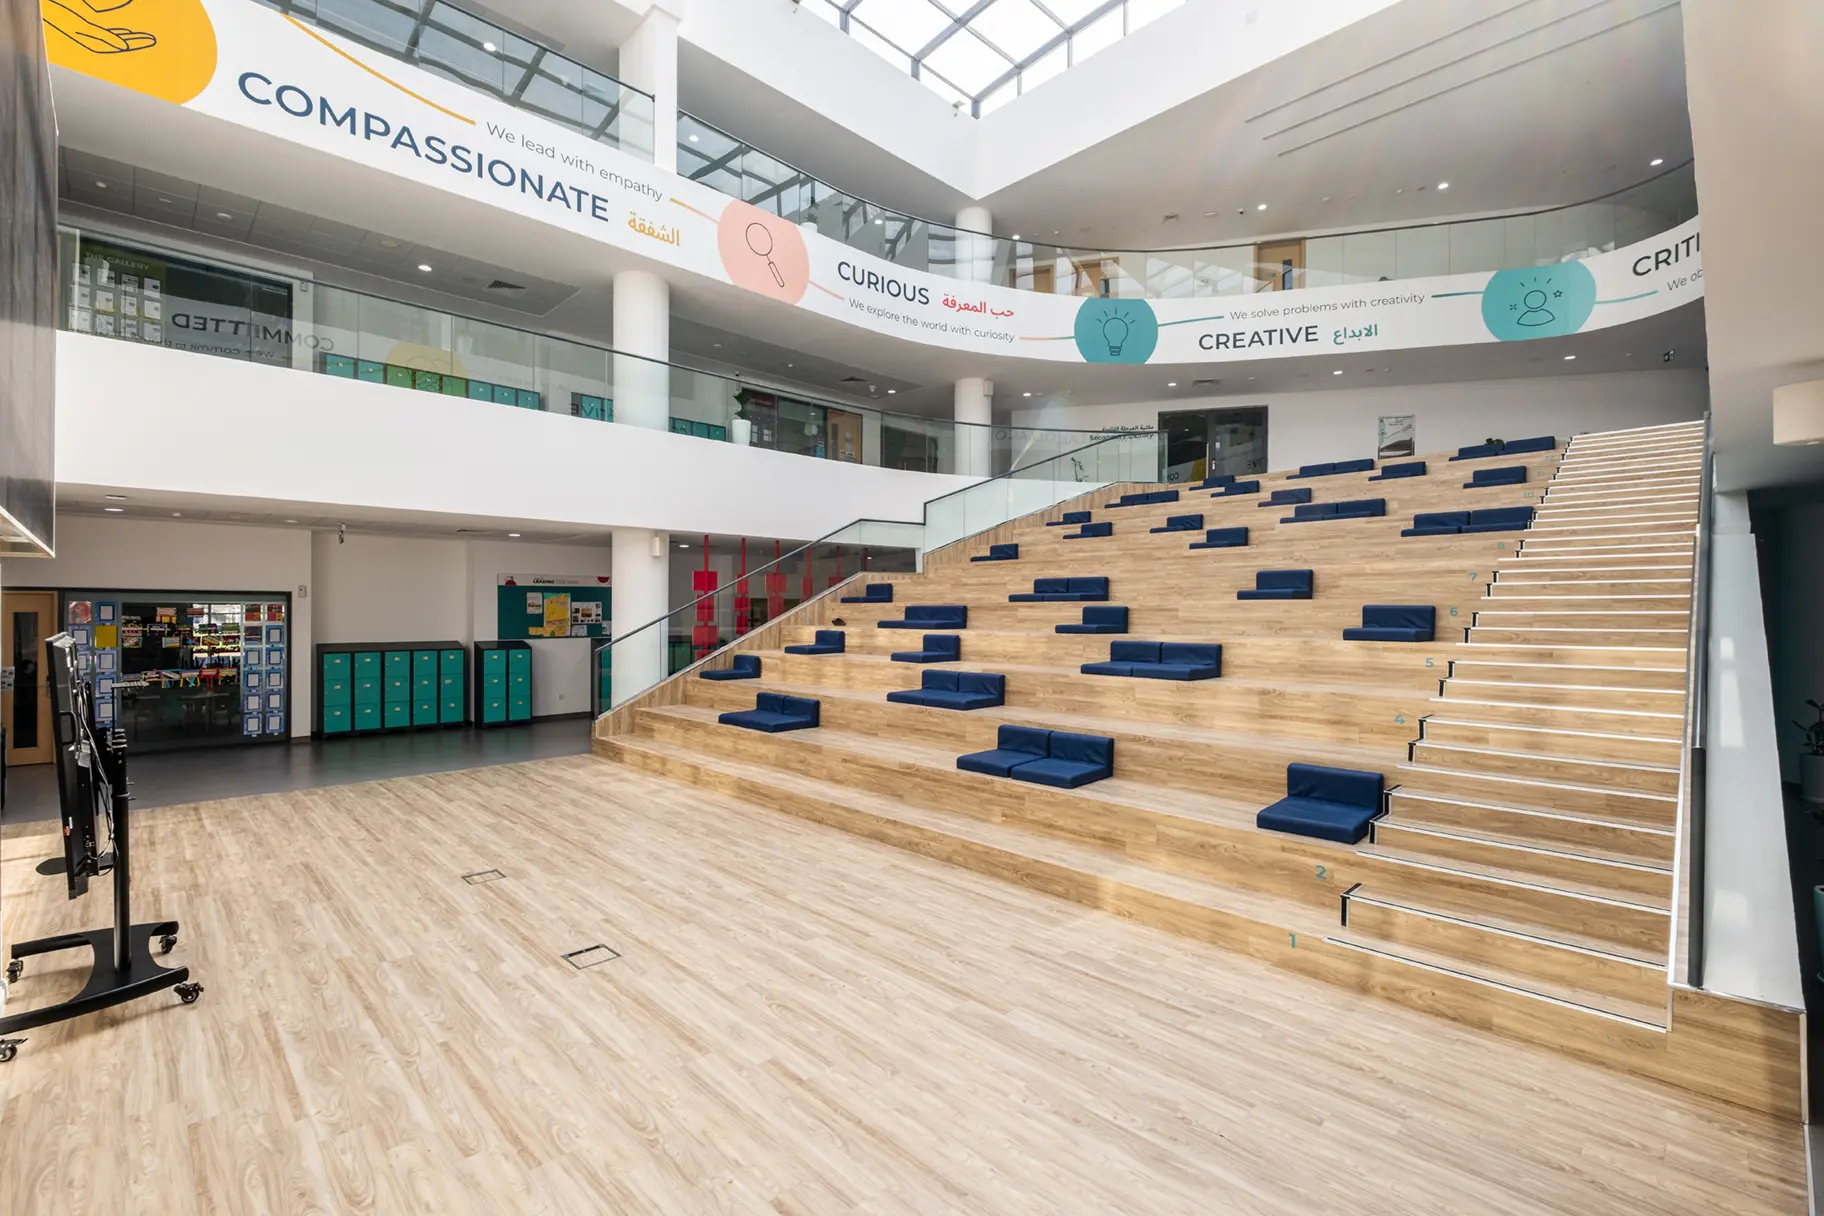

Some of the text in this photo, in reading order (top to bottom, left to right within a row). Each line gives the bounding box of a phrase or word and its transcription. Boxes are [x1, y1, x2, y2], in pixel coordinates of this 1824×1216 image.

[237, 71, 609, 223] COMPASSIONATE
[486, 120, 663, 203] We lead with empathy
[627, 210, 681, 247] الشفقة
[106, 256, 150, 271] GALLERY
[837, 261, 930, 306] CURIOUS
[1667, 277, 1687, 291] We
[941, 293, 1015, 320] حب المعرفة
[1229, 293, 1425, 321] We solve problems with creativity
[849, 297, 1015, 344] We explore the world with curiosity
[1199, 325, 1319, 351] CREATIVE
[1333, 324, 1379, 345] الابداع
[1469, 572, 1477, 580] 7
[1450, 607, 1458, 616] 6
[1425, 657, 1434, 668] 5
[1394, 713, 1405, 725] 4
[1315, 865, 1328, 880] 2
[1289, 932, 1296, 949] 1
